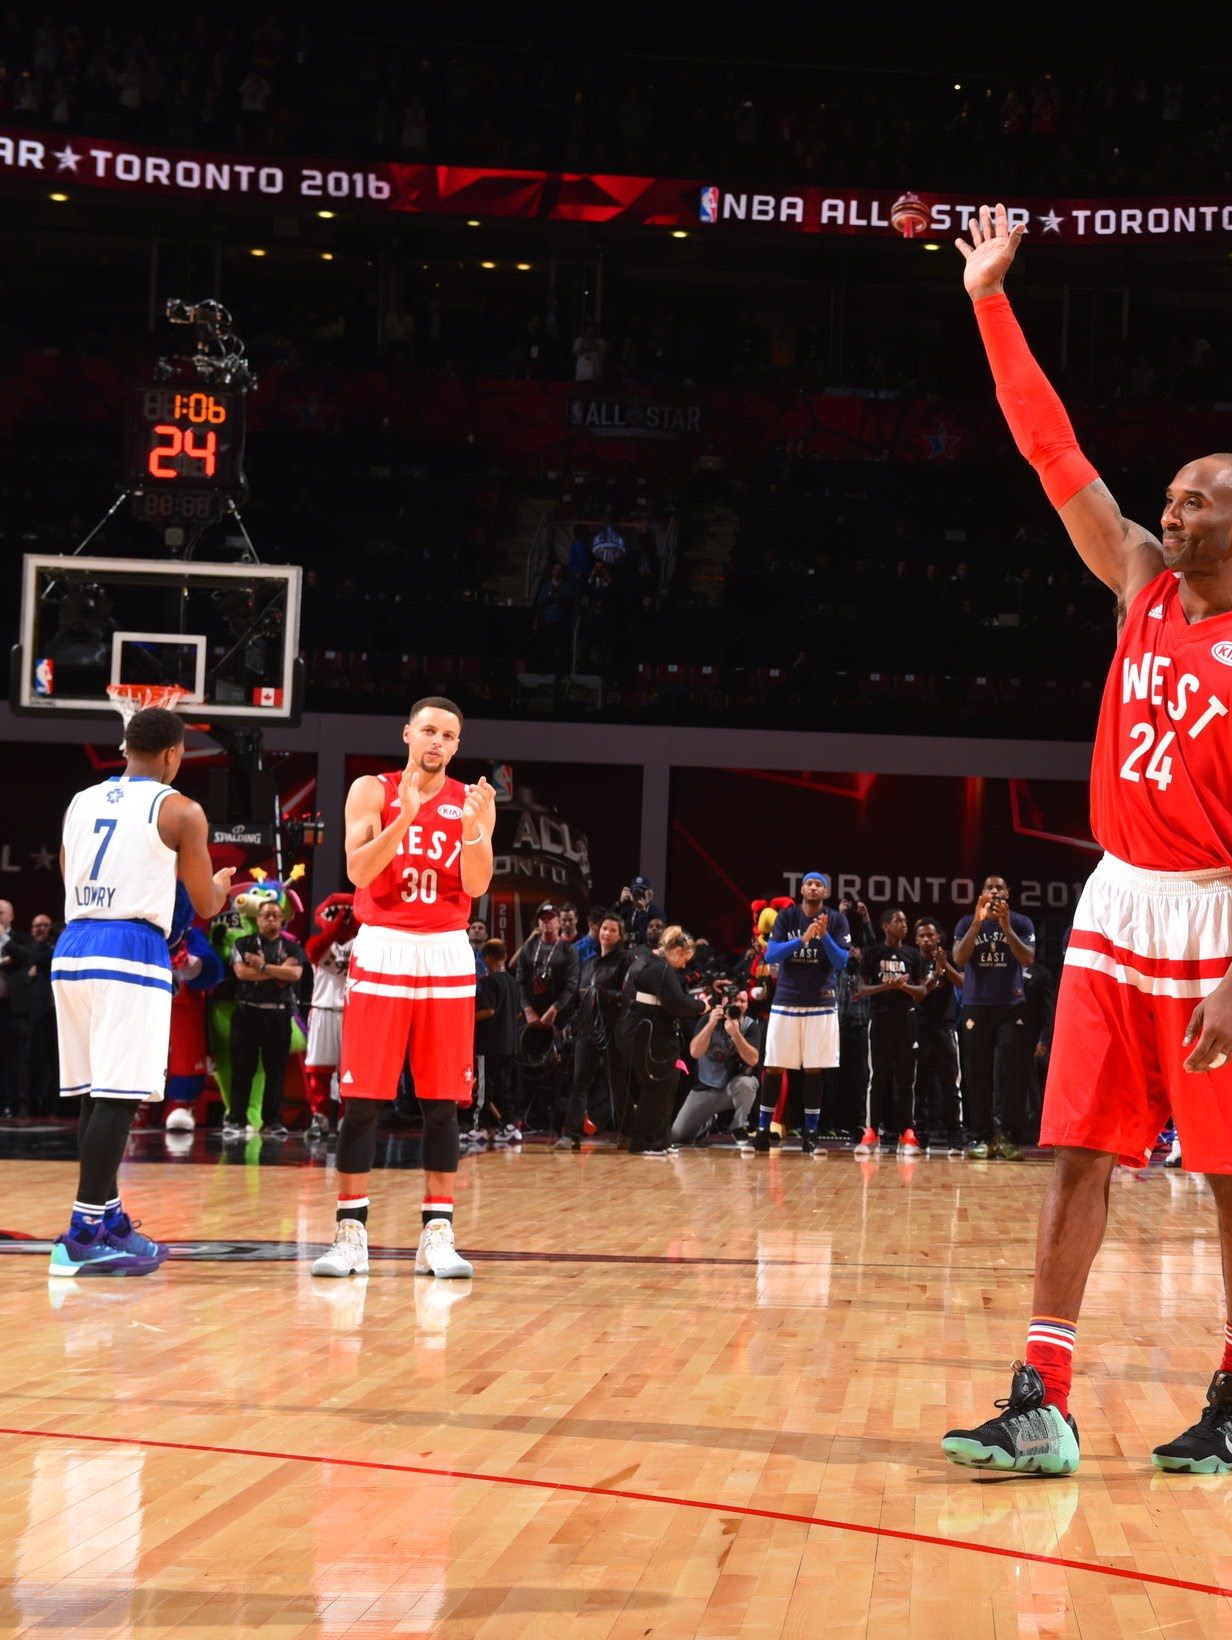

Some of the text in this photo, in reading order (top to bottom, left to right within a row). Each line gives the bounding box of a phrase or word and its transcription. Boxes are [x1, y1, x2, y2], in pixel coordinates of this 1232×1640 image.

[90, 149, 283, 194] TORONTO
[301, 169, 391, 200] 2016
[722, 193, 804, 222] NBA
[820, 199, 889, 227] ALL
[173, 392, 228, 424] 1:06
[645, 406, 701, 433] STAR
[148, 424, 217, 479] 24
[1122, 651, 1229, 740] WEST
[1120, 722, 1176, 791] 24
[89, 818, 118, 881] 7
[213, 831, 262, 844] SPALDING
[395, 825, 462, 869] EST
[75, 886, 116, 908] LOWRY
[400, 866, 438, 905] 30
[782, 871, 975, 906] TRONTO
[981, 952, 1005, 963] EAST
